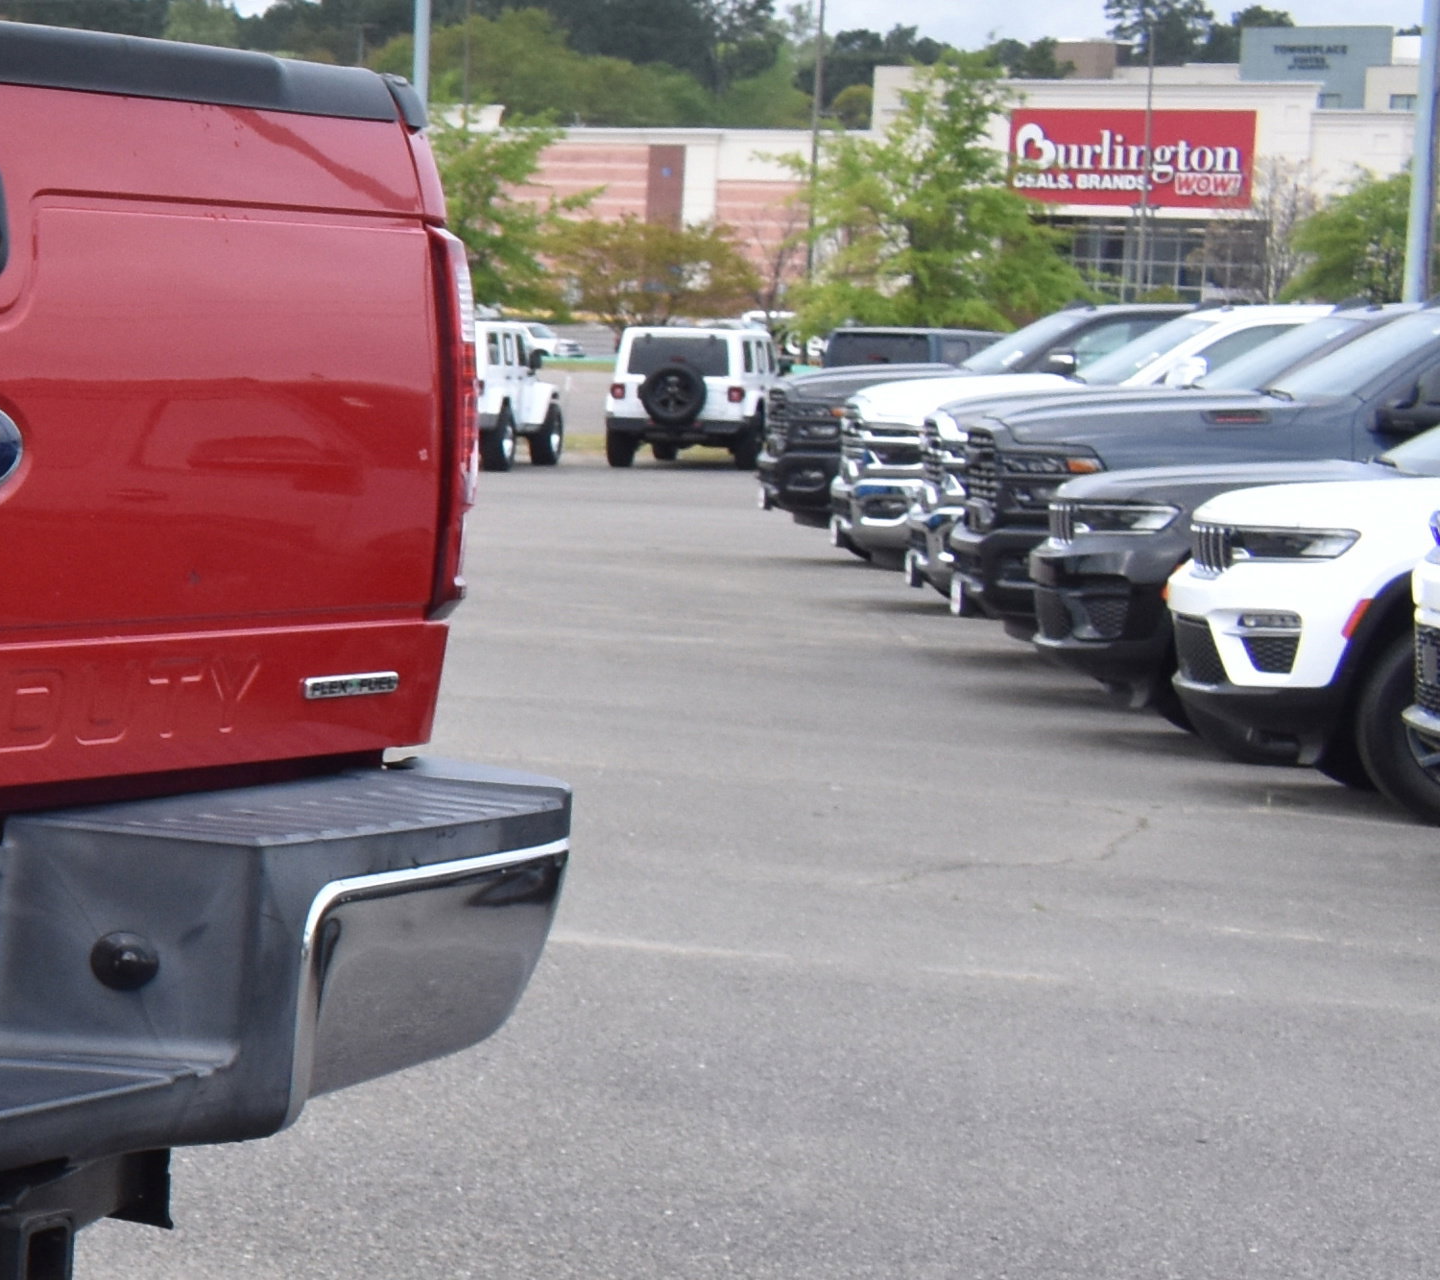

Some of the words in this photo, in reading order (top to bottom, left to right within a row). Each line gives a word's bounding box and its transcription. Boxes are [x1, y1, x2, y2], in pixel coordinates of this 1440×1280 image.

[1016, 123, 1242, 183] Burlington
[310, 680, 348, 697] FLEX
[359, 676, 396, 691] FUEL
